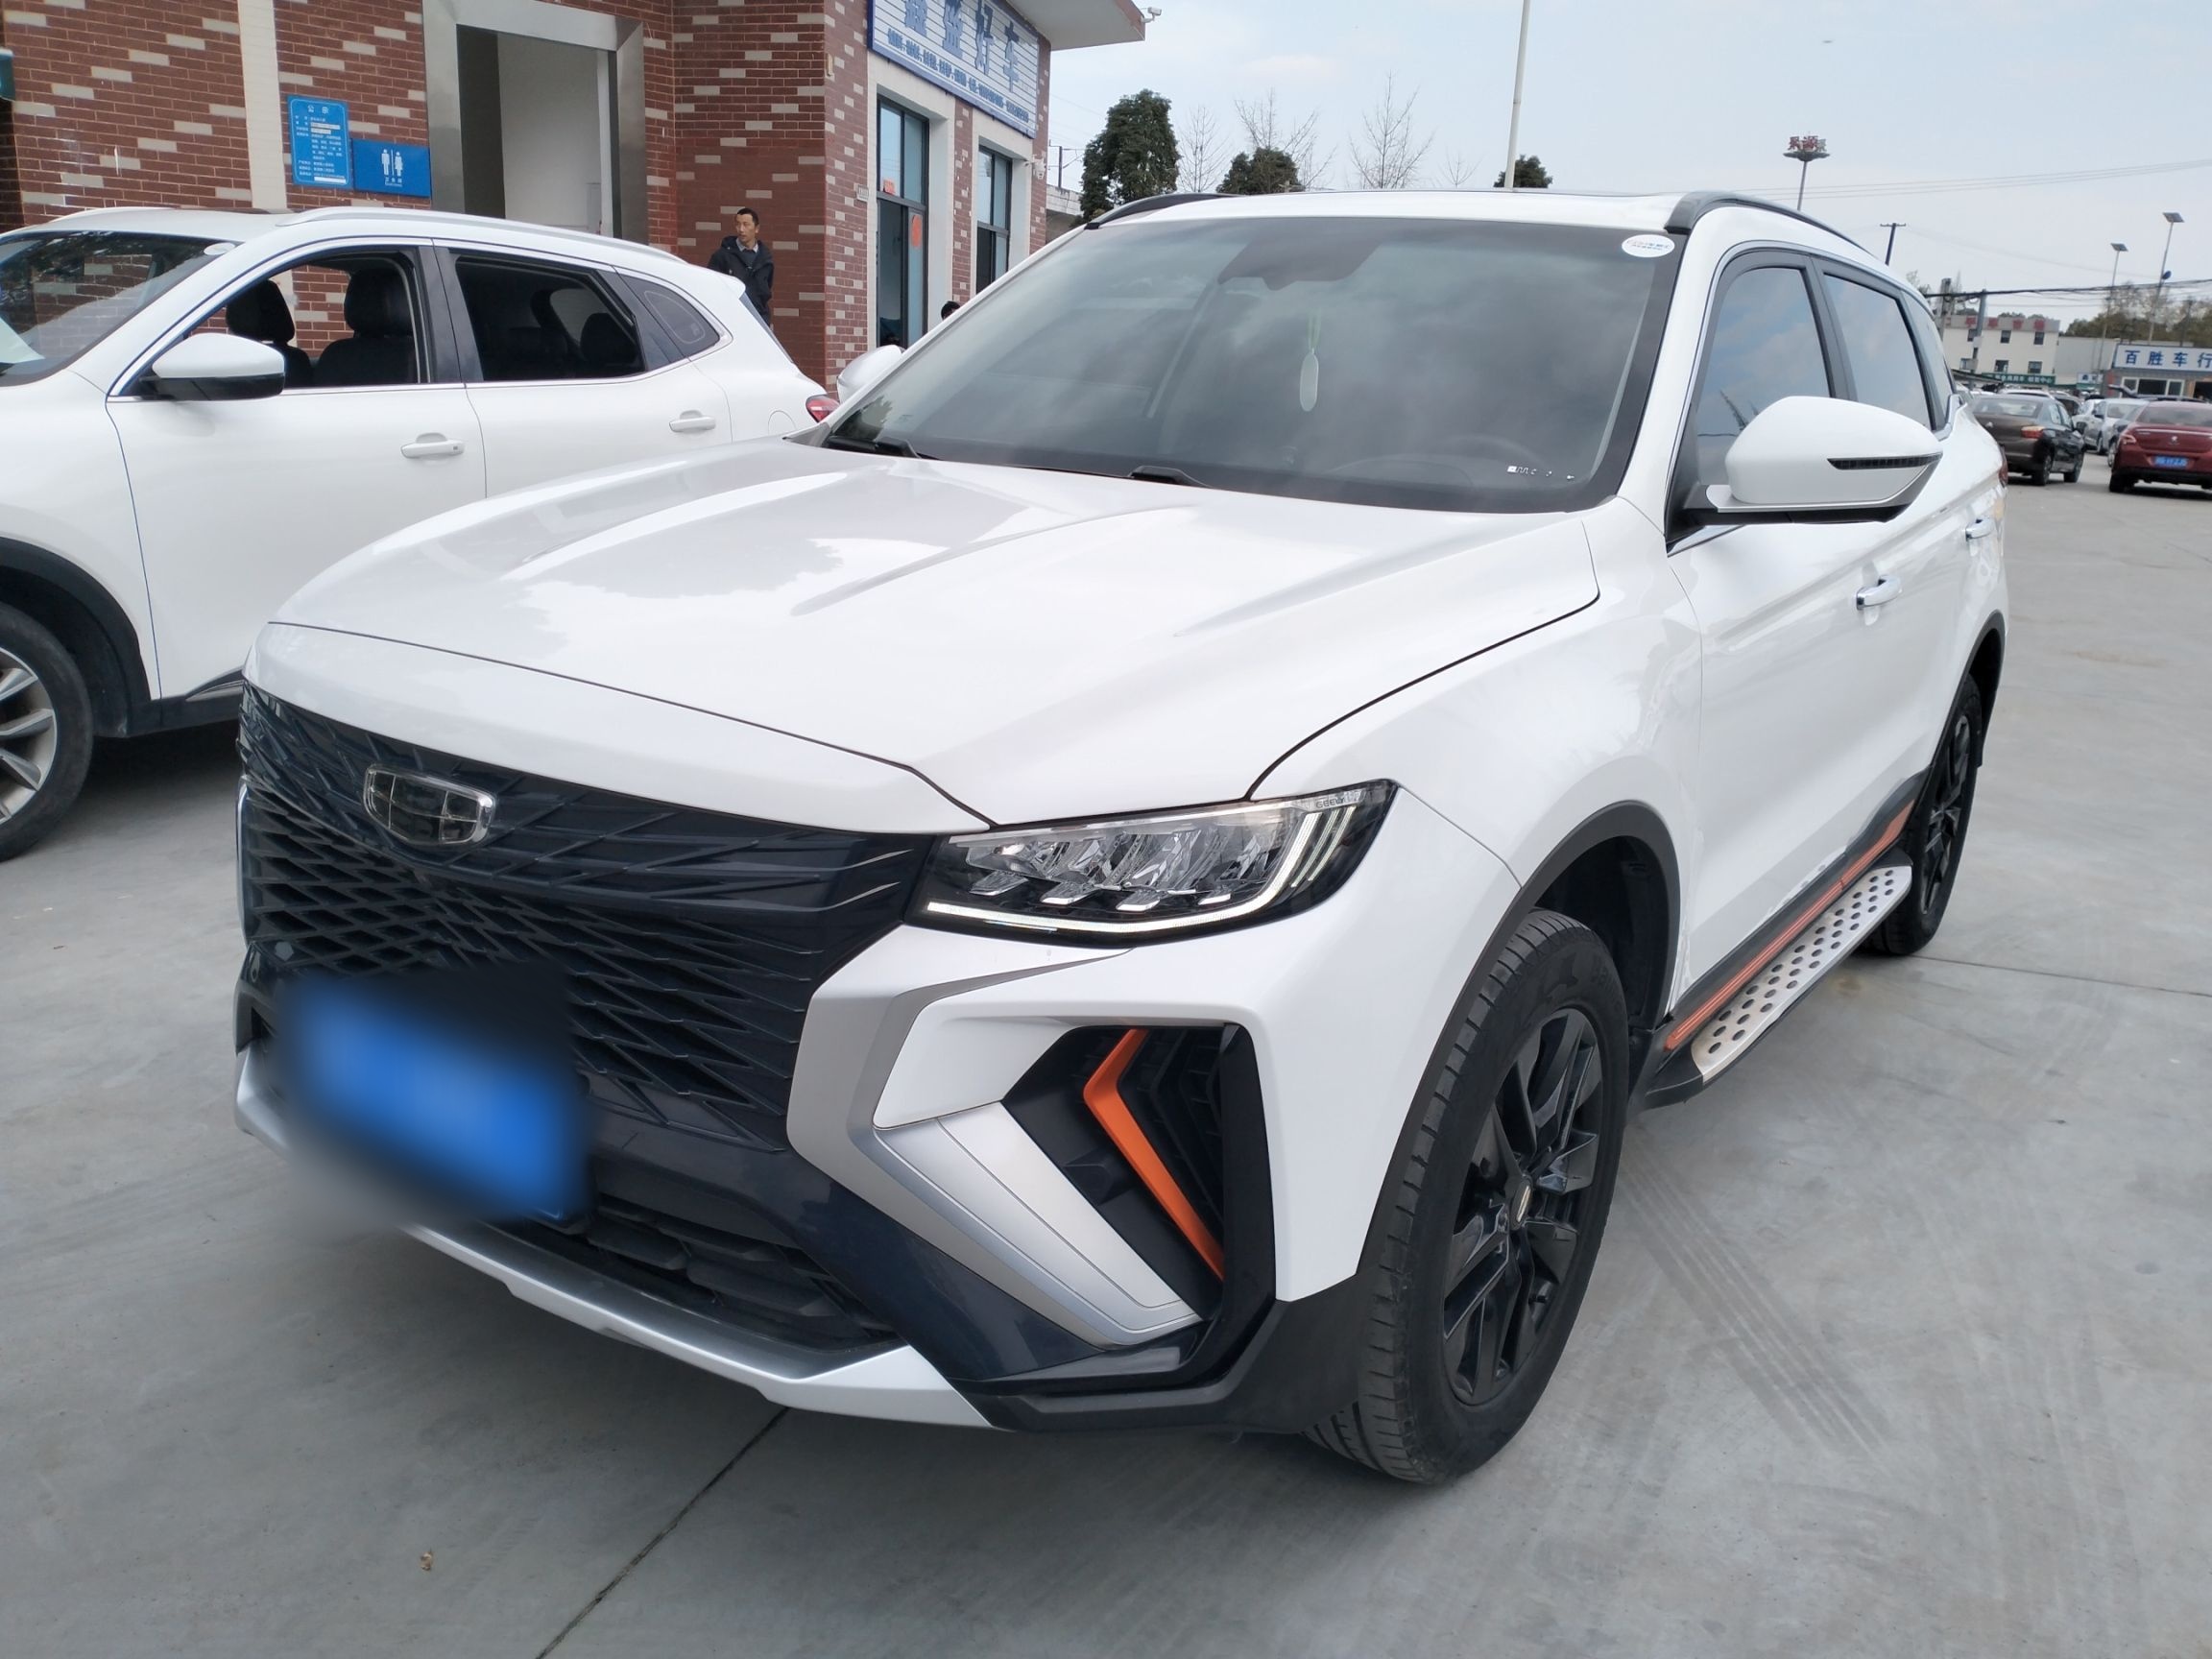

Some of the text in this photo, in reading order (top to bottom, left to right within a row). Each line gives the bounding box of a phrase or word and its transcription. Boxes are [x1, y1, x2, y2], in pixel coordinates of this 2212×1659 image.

[2125, 349, 2212, 369] 百胜车行
[1316, 797, 1344, 808] GEELY
